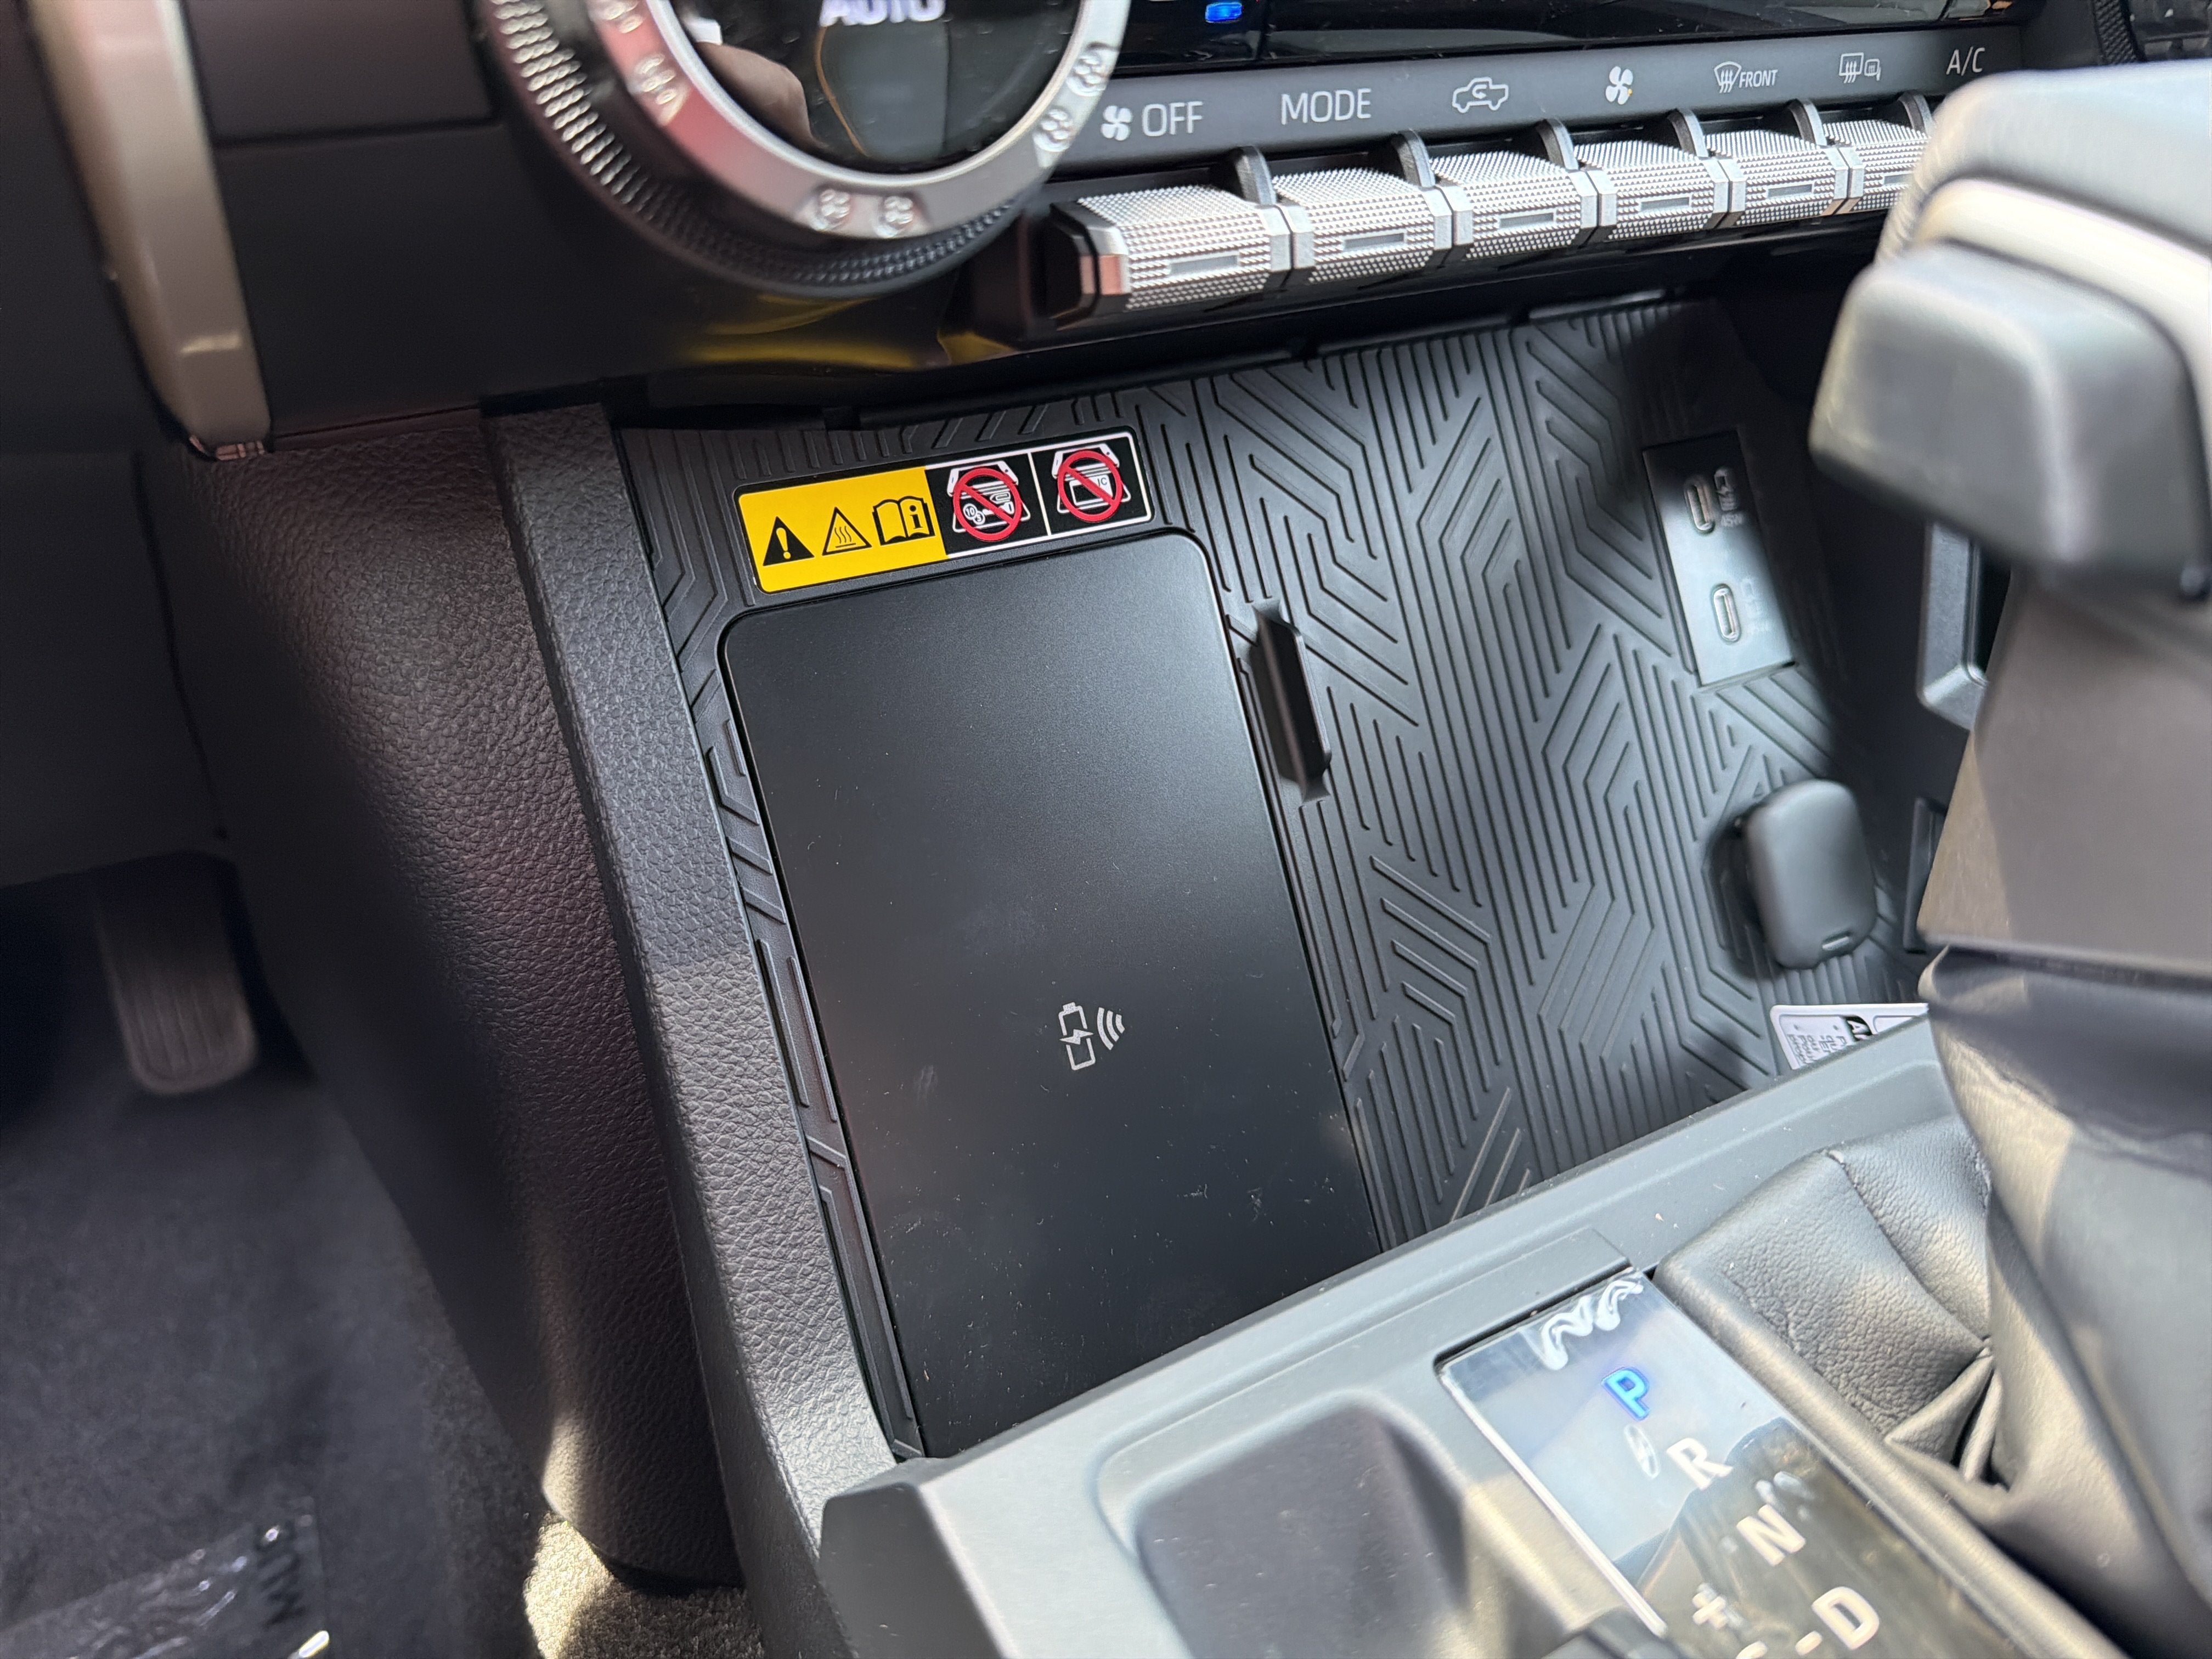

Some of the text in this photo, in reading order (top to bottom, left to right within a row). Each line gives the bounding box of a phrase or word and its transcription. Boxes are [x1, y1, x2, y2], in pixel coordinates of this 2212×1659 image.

[1739, 69, 1778, 89] FRONT
[1946, 48, 1985, 75] A/C
[1142, 101, 1203, 137] OFF
[1281, 88, 1372, 125] MODE
[1601, 1367, 1650, 1421] P
[1666, 1438, 1733, 1489] R
[1736, 1504, 1806, 1567] N
[1812, 1586, 1880, 1650] D
